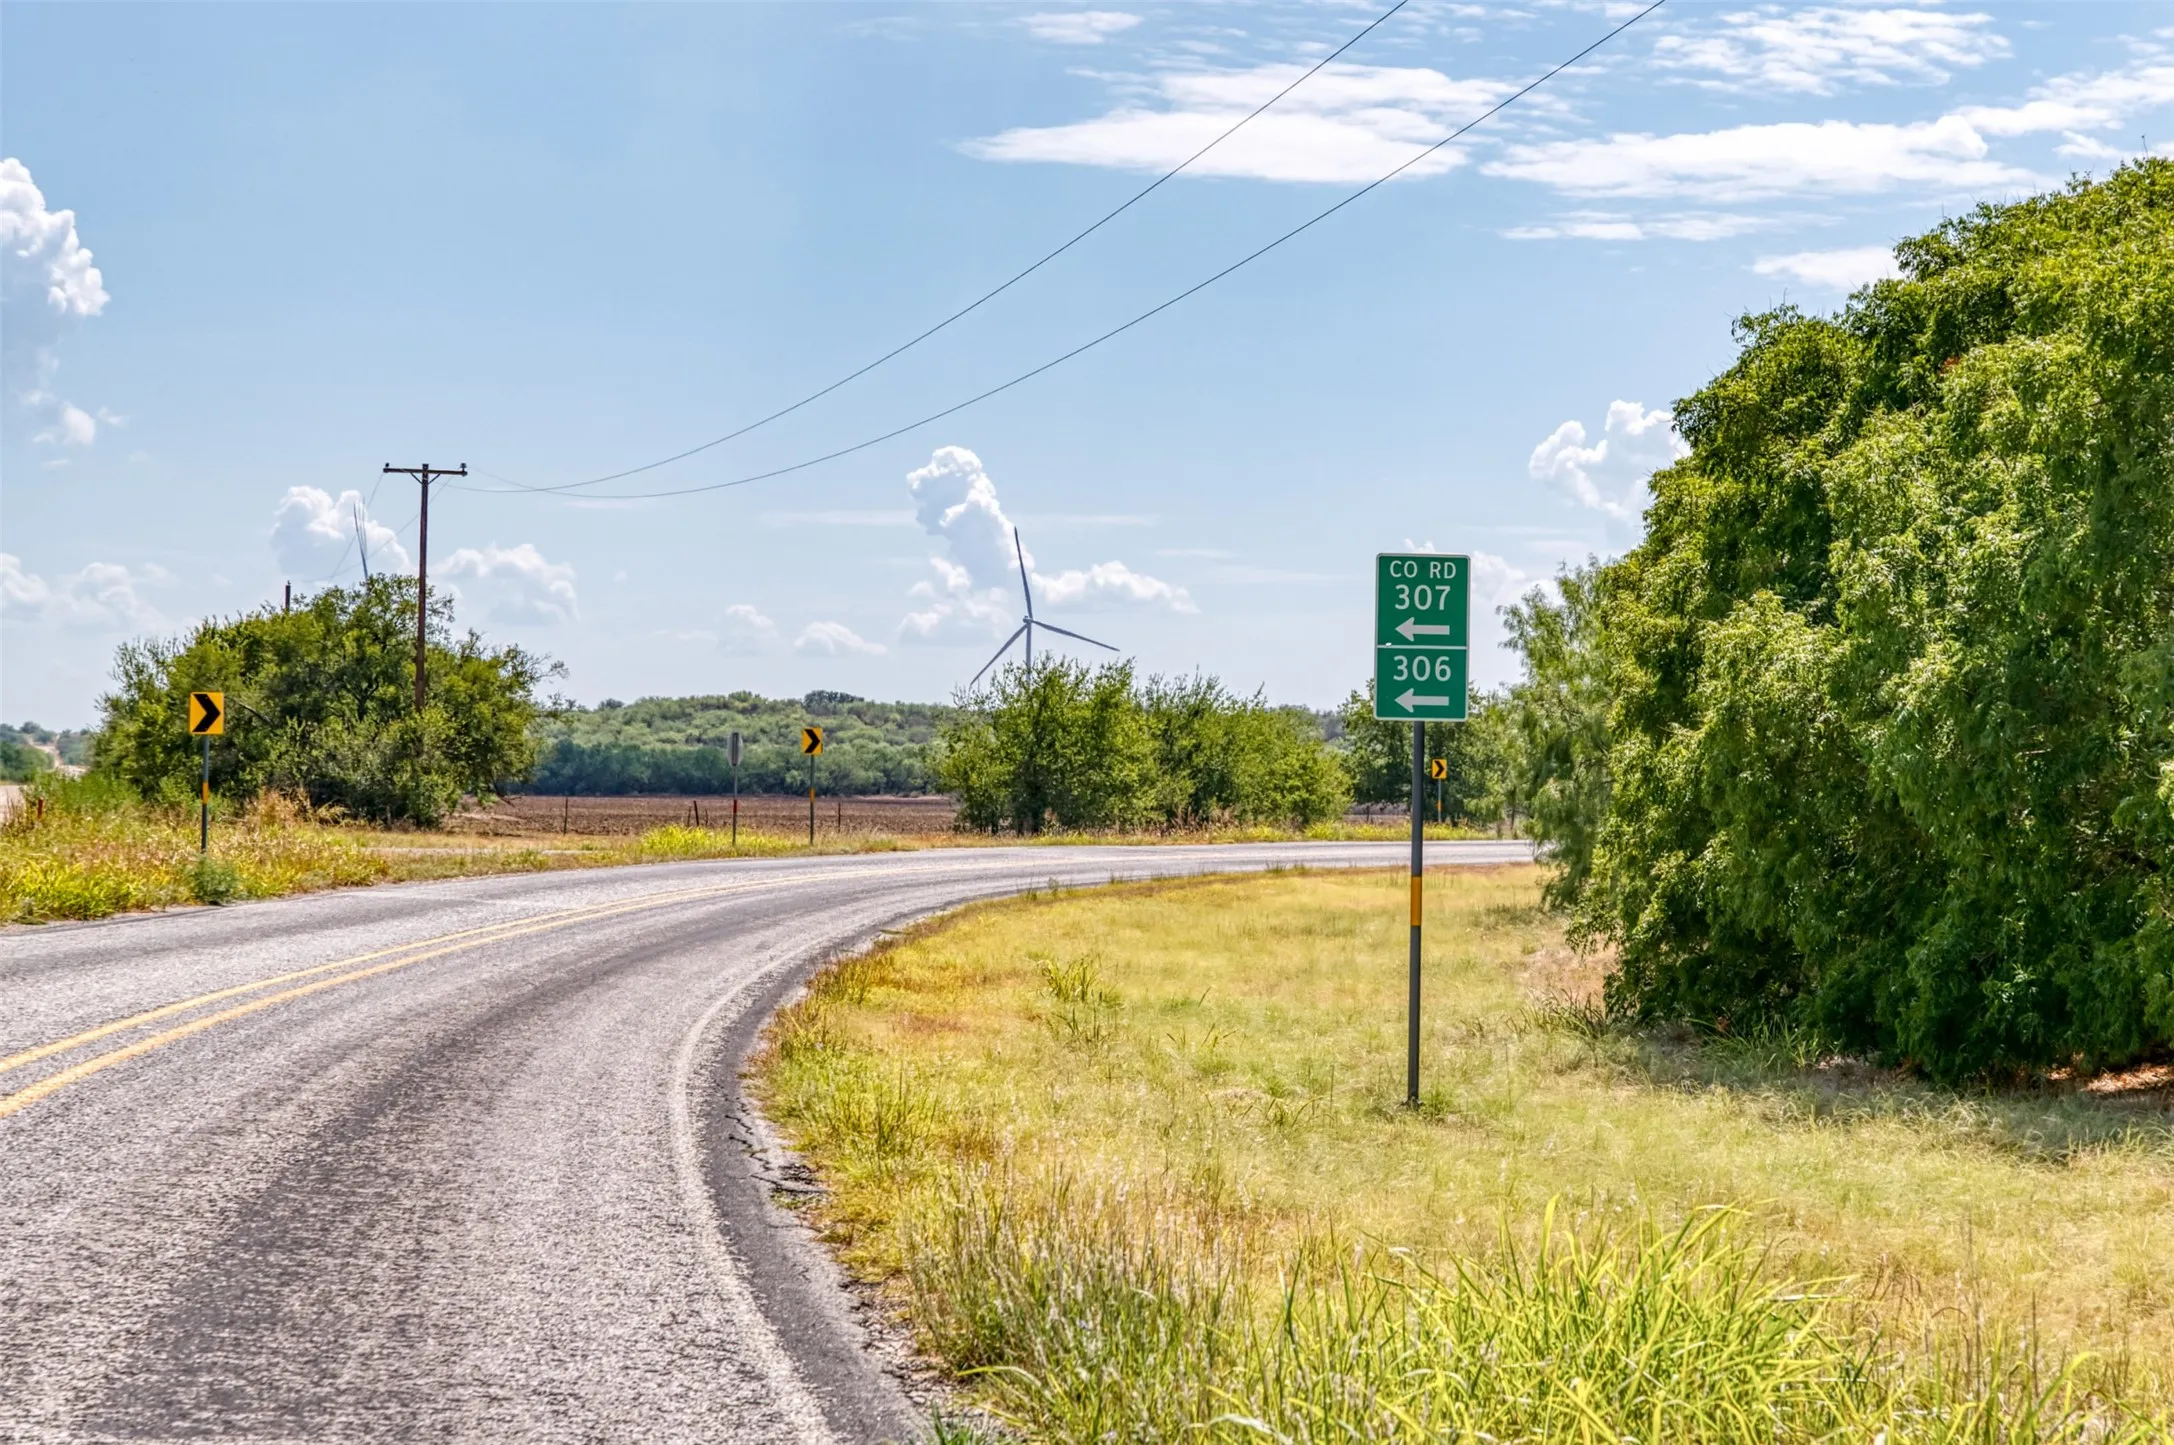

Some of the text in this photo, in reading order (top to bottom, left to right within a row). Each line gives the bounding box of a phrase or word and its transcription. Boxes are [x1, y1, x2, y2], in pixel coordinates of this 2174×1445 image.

[1390, 561, 1456, 578] CO RD
[1395, 585, 1450, 610] 307
[1394, 656, 1451, 681] 306
